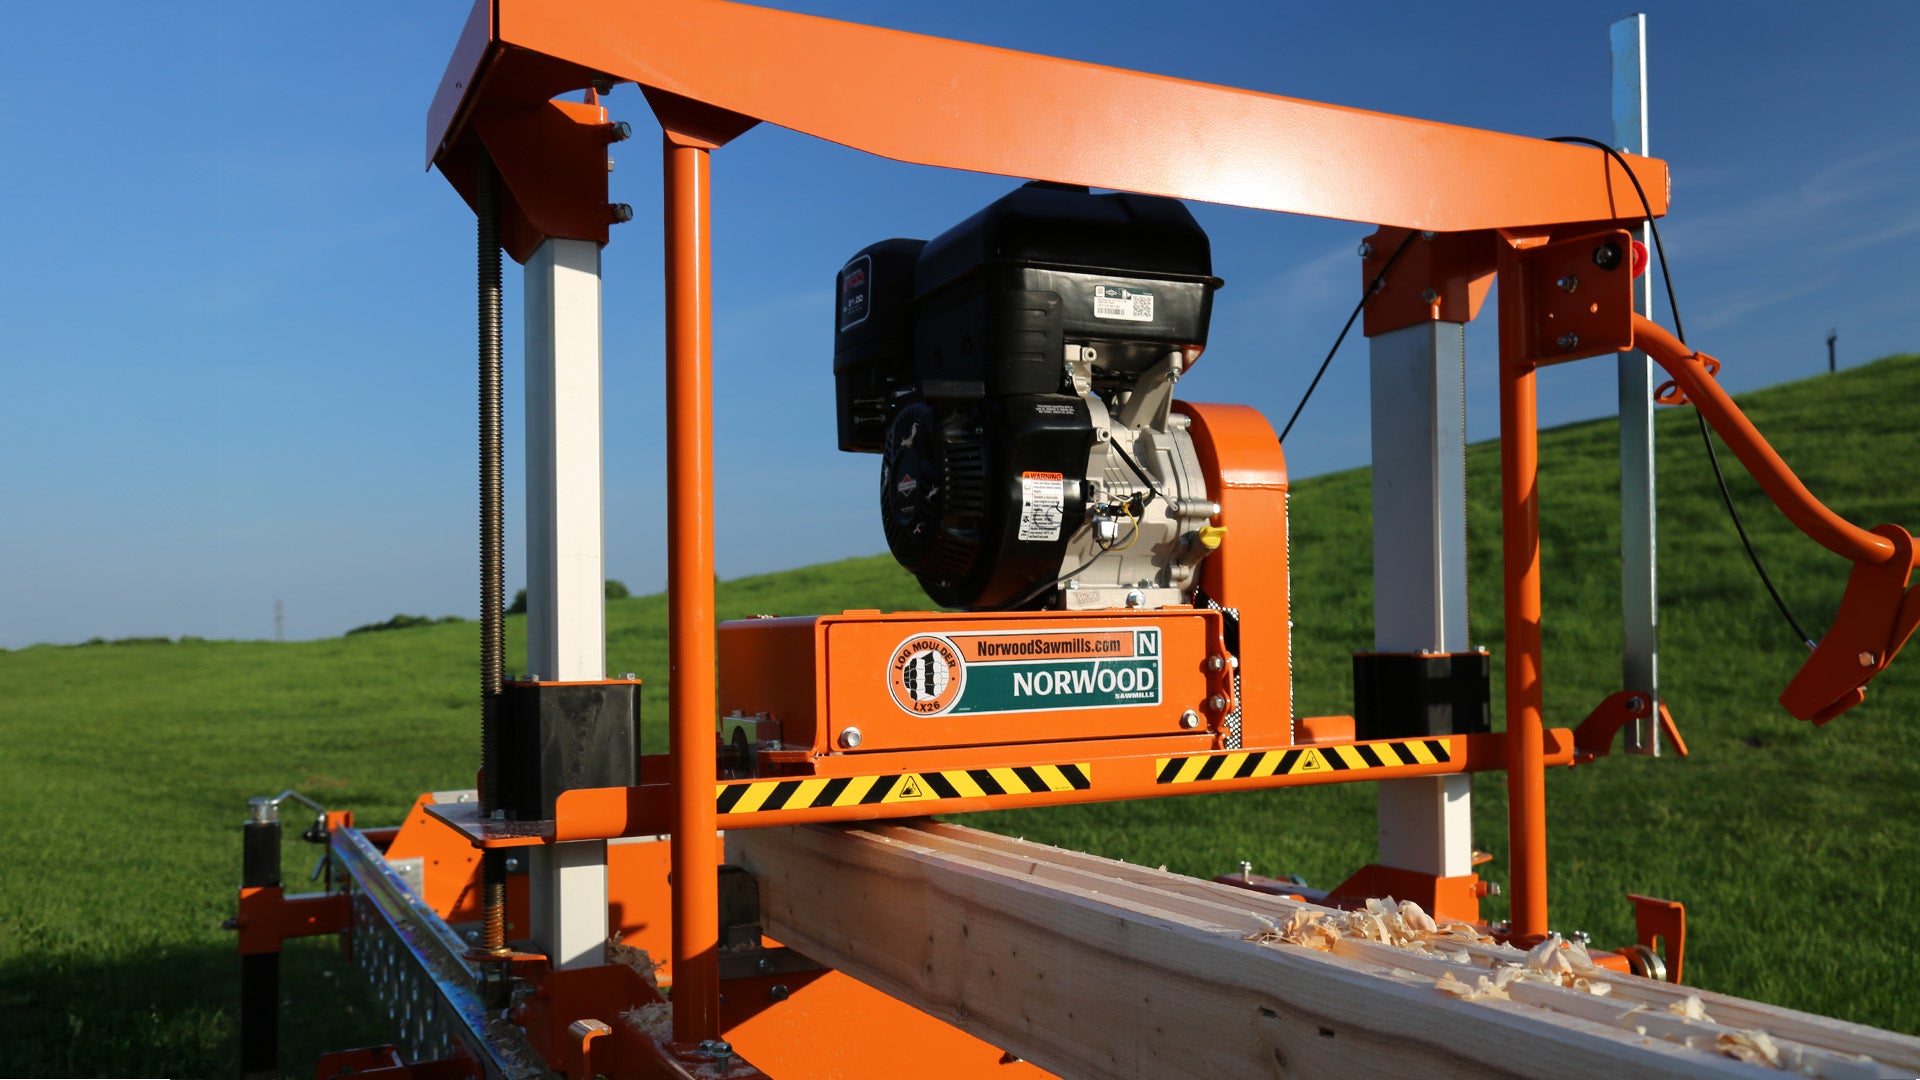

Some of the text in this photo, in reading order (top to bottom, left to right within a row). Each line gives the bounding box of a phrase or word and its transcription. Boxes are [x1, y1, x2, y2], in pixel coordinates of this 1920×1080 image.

[1030, 473, 1062, 481] WARNING
[977, 638, 1121, 657] NorwoodSawmills.com
[1139, 633, 1156, 655] N
[895, 641, 956, 671] LOG MOULDER
[1013, 663, 1155, 697] NORWOOD
[1114, 692, 1155, 700] SAWMILLS
[913, 701, 941, 713] LX26
